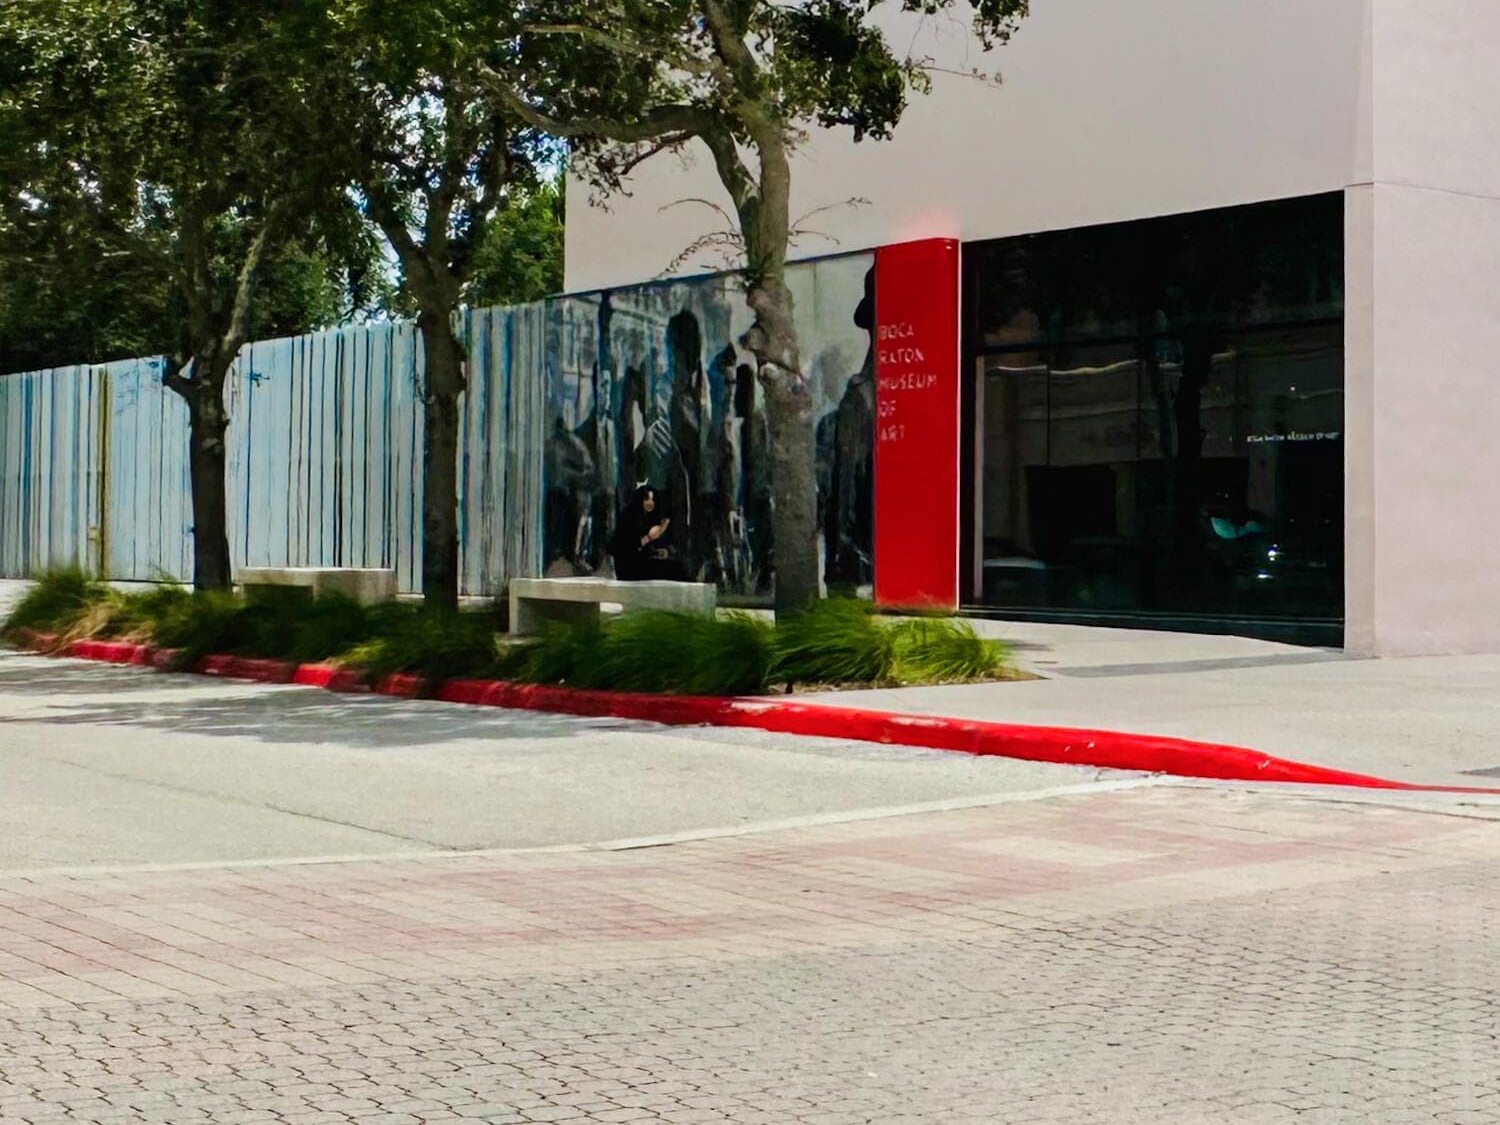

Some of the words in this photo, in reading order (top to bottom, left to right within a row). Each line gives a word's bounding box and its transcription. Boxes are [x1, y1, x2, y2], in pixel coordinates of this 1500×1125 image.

[878, 322, 915, 341] BOCA
[878, 348, 925, 364] RATON
[878, 372, 938, 391] MUSEUM
[879, 399, 897, 418] OF
[880, 424, 906, 442] ART
